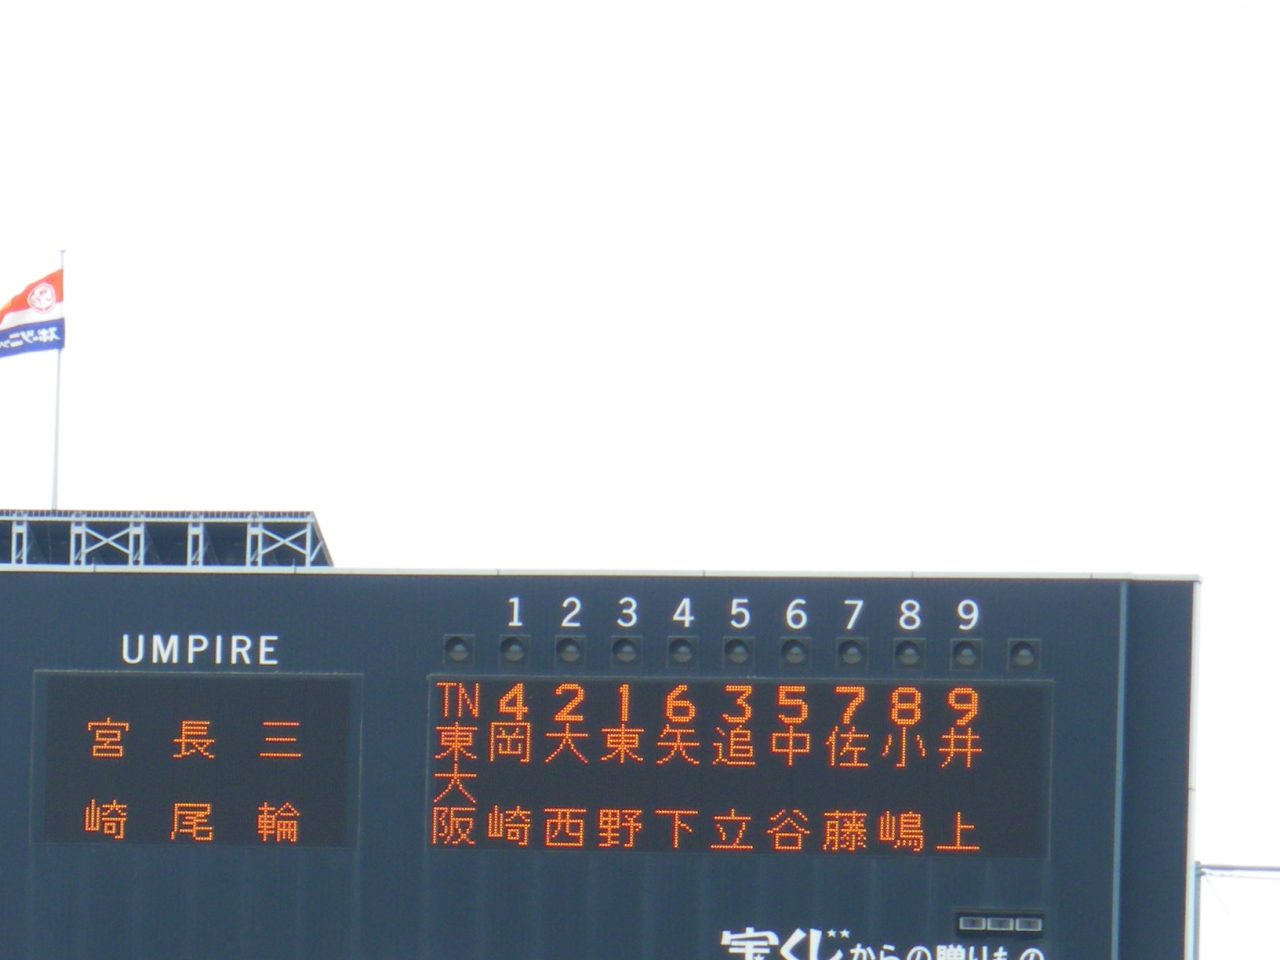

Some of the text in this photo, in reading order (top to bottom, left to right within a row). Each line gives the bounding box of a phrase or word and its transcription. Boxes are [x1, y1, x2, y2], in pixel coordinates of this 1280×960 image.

[508, 597, 979, 631] 1 2 3 4 5 6 7 8 9
[122, 634, 279, 665] UMPIRE
[436, 682, 978, 726] TN 4 2 1 6 3 5 7 8 9
[431, 722, 479, 845] 東大阪
